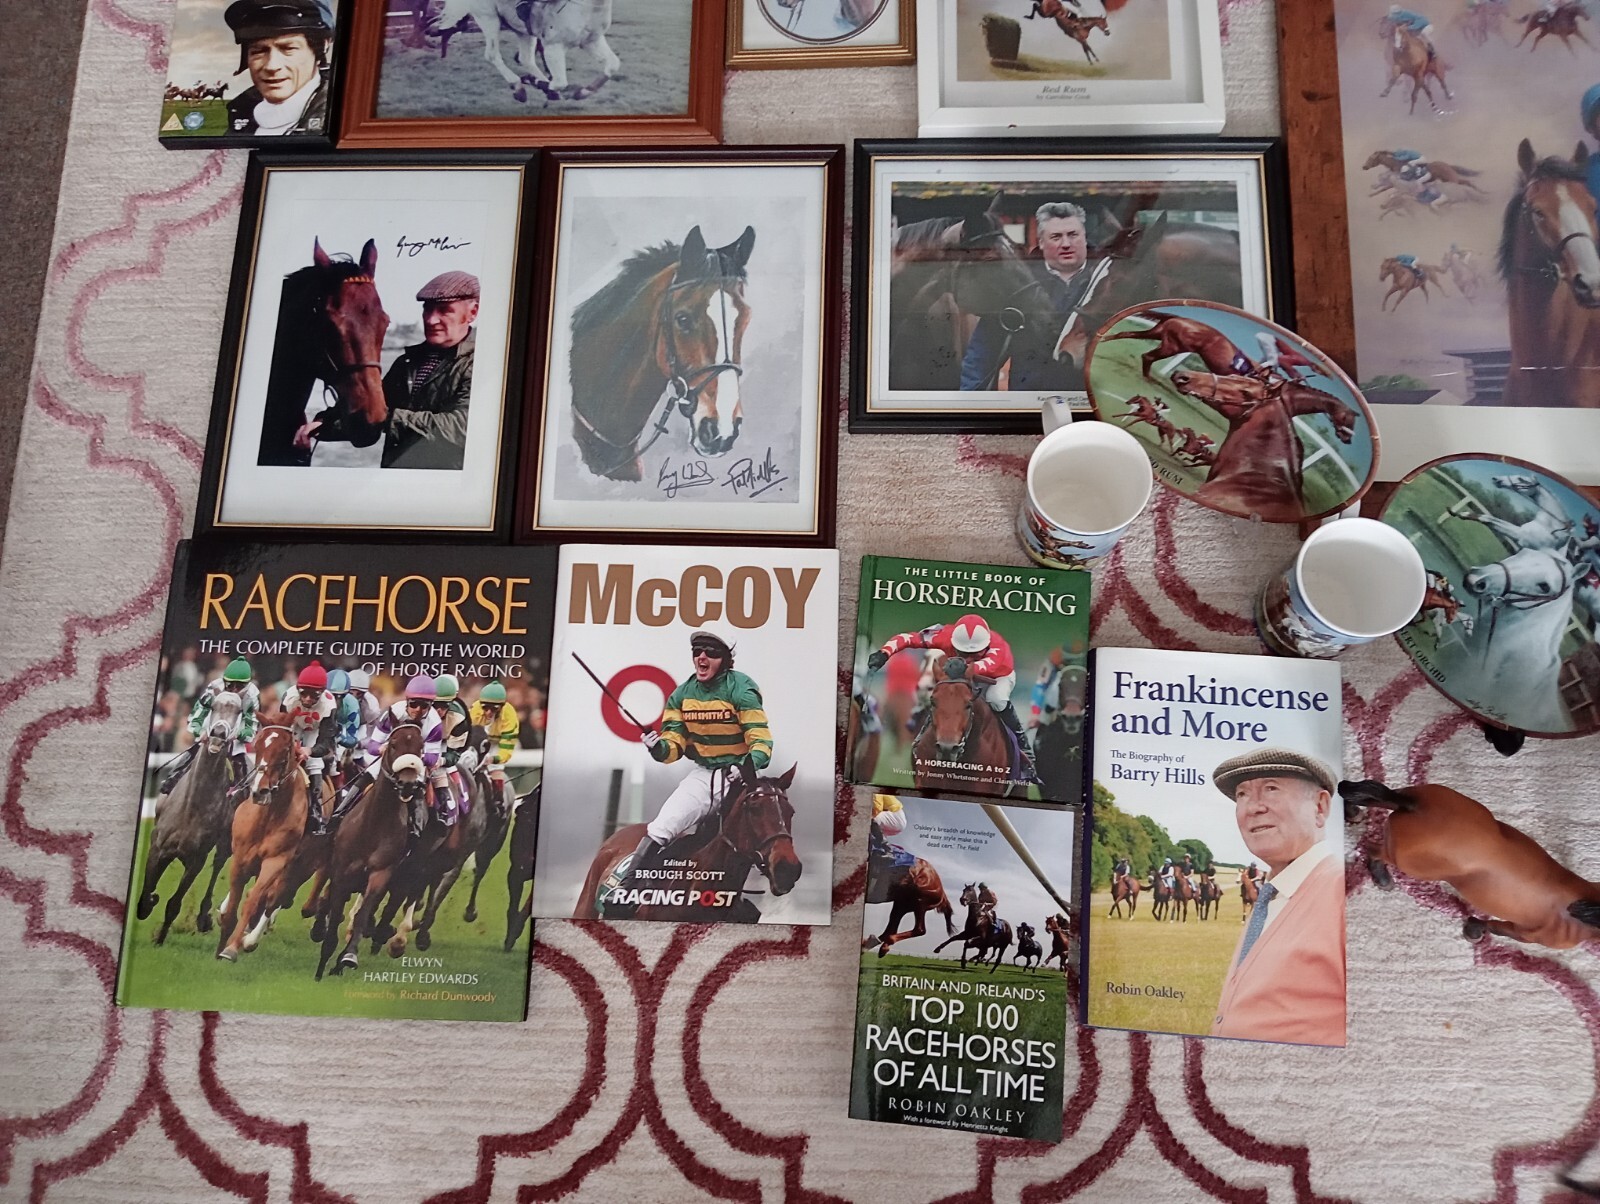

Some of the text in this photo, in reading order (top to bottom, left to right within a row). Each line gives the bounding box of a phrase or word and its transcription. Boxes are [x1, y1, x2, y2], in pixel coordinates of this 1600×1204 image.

[1160, 468, 1182, 484] RUM
[904, 567, 1046, 586] THE LITTLE BOOK OF
[200, 573, 530, 635] RACEHORSE
[568, 563, 821, 629] McCOY
[873, 579, 1076, 615] HORSERACING
[200, 640, 525, 659] THE COMPLETE GUIDE TO THE WORLD
[362, 662, 522, 678] OF HORSE RACING
[1416, 651, 1446, 682] ORCHID
[1113, 671, 1328, 712] Frankincense
[1111, 707, 1268, 742] and More
[925, 760, 984, 771] HORSERACING
[1111, 750, 1185, 764] The Biography of
[927, 771, 945, 779] Jonny
[946, 773, 980, 781] Whetstone
[1111, 764, 1205, 786] Barry Hills
[967, 830, 995, 838] knowledge
[688, 860, 697, 868] by
[635, 870, 725, 881] BROUGH SCOTT
[613, 889, 737, 906] RACING POST
[402, 957, 442, 967] ELWYN
[364, 972, 478, 984] HARTLEY EDWARDS
[386, 991, 395, 1000] by
[400, 990, 438, 1000] Richard
[442, 991, 496, 1003] Dunwoody
[882, 975, 1045, 1001] BRITAIN AND IRELAND'S
[1107, 982, 1186, 1002] Robin Oakley
[905, 995, 1019, 1031] TOP 100
[865, 1024, 1056, 1069] RACEHORSES
[873, 1058, 1045, 1102] OF ALL TIME
[888, 1097, 1025, 1123] ROBIN OAKLEY
[925, 1117, 951, 1126] foreword
[961, 1122, 988, 1130] Henrietta
[990, 1125, 1008, 1134] Knight
